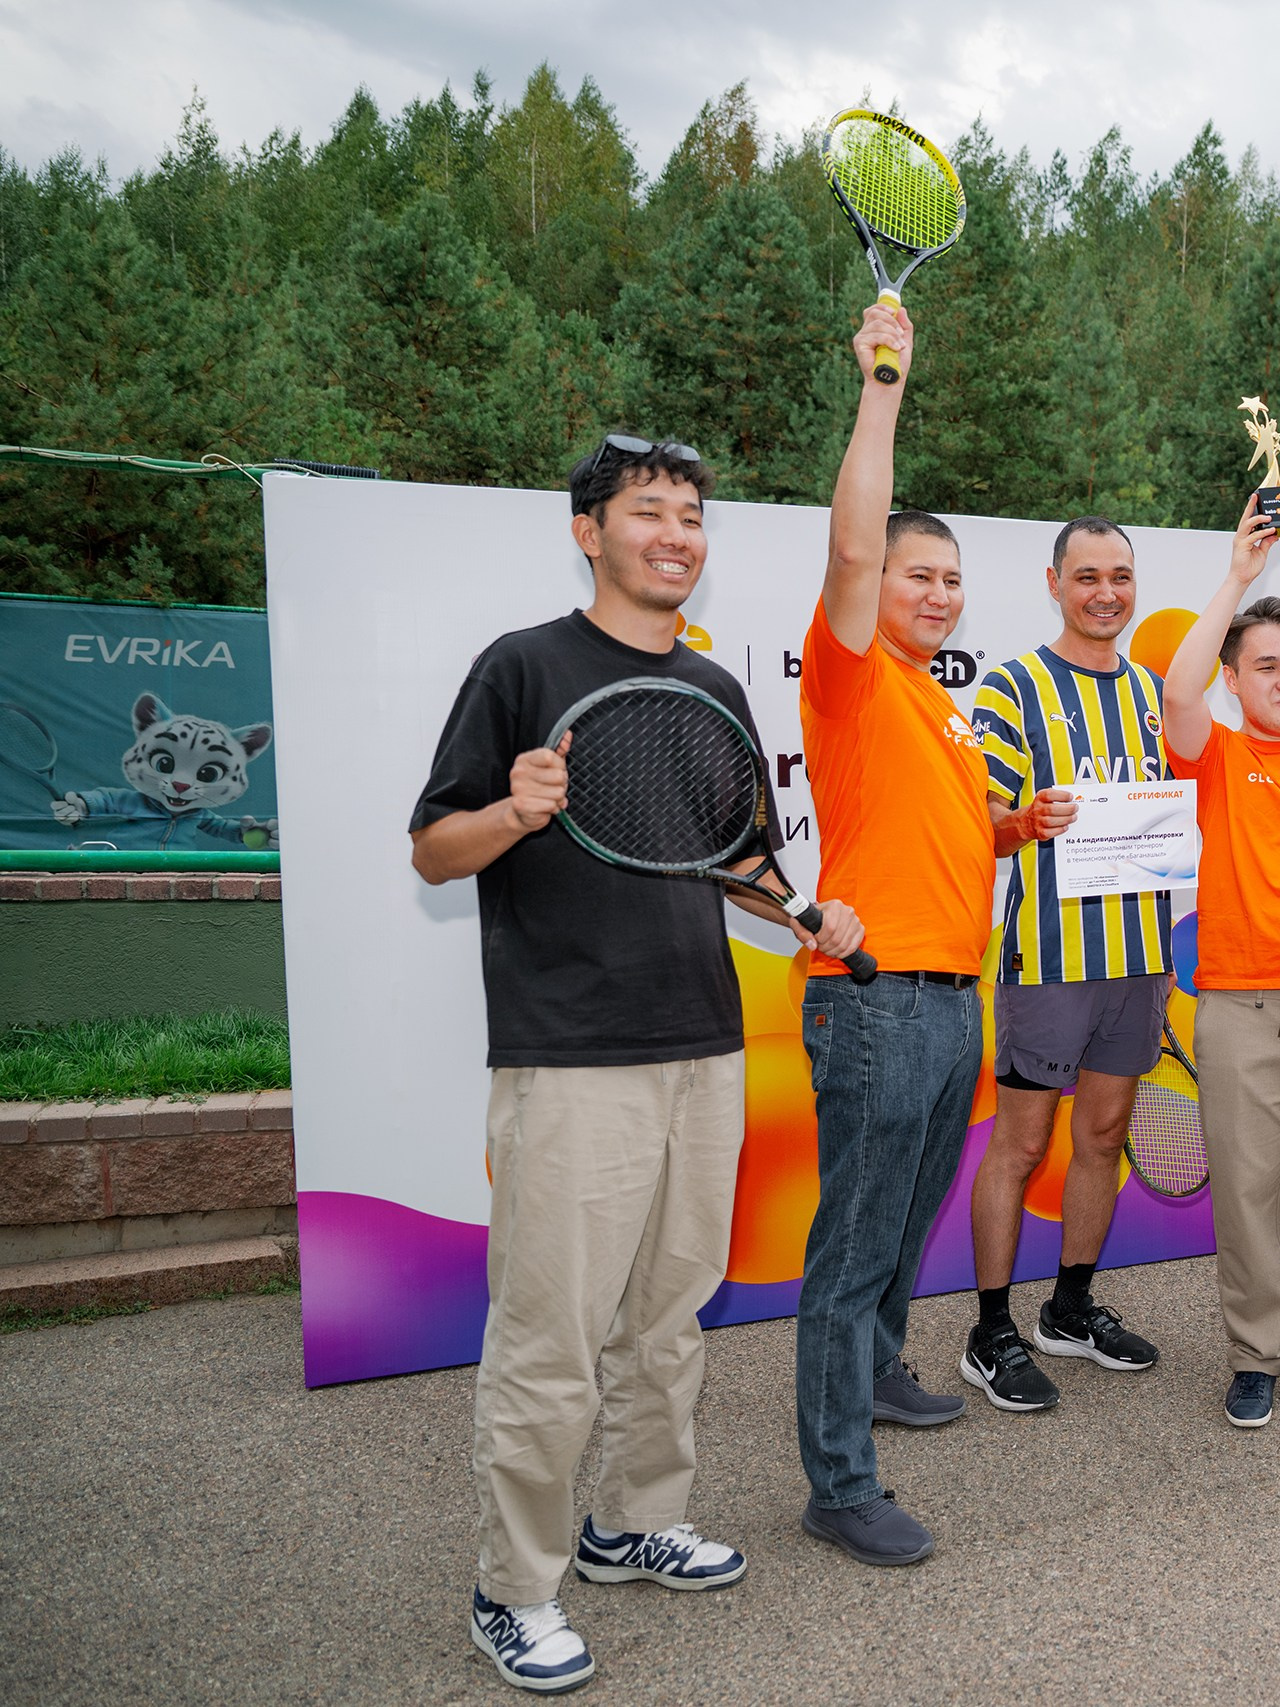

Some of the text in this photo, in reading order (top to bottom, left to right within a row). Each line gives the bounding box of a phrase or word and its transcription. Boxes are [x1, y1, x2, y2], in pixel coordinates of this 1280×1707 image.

[1074, 756, 1158, 785] AVIS
[1127, 790, 1184, 801] СЕРТИФИКАТ
[1066, 837, 1075, 845] На
[1082, 835, 1142, 845] индивидуальные
[1143, 832, 1184, 841] тренировки
[1071, 844, 1133, 855] профессиональным
[1134, 842, 1164, 851] тренером
[1072, 855, 1106, 863] теннисном
[1108, 853, 1125, 863] клубе
